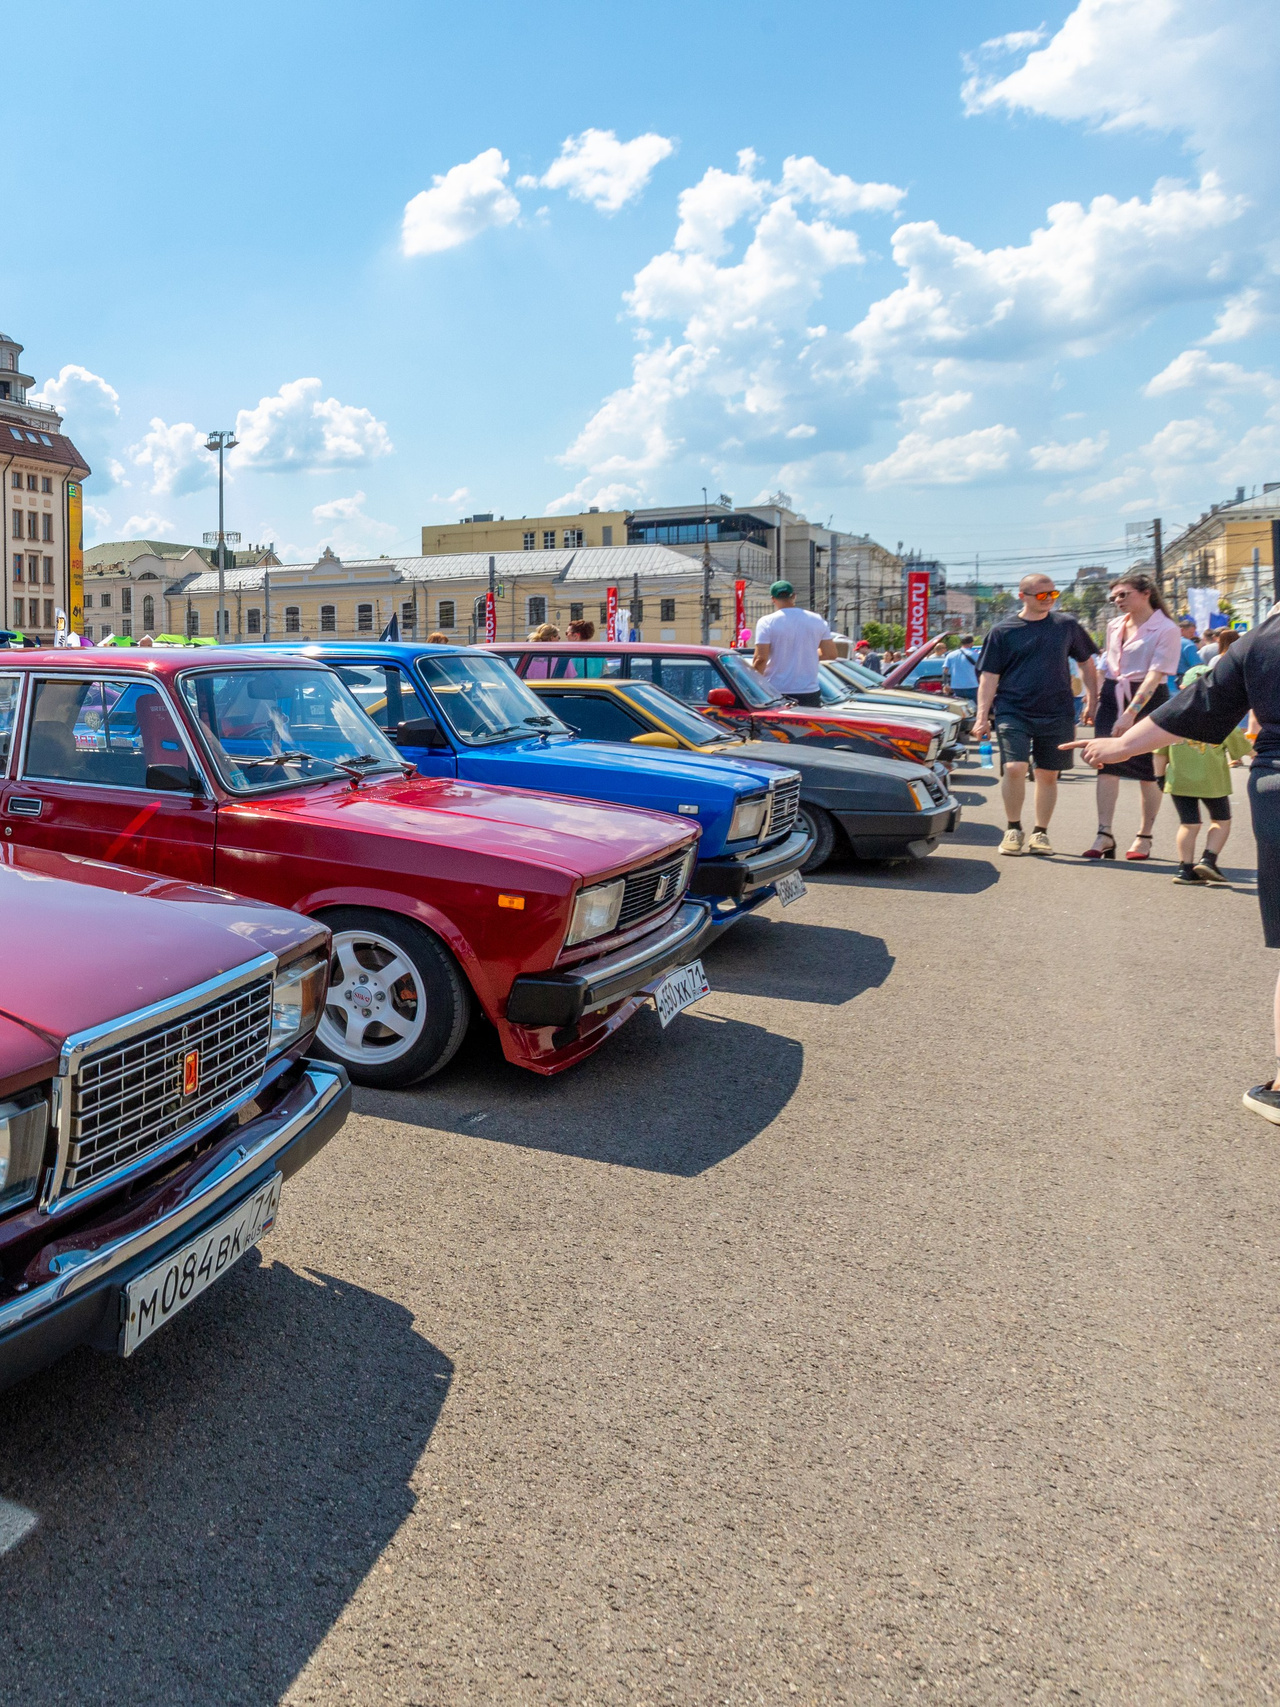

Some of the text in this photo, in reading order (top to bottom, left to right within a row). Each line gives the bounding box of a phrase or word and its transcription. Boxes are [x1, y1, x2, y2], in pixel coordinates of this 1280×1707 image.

[910, 582, 926, 648] auto.ru
[687, 965, 704, 989] 71
[245, 1224, 262, 1247] RUS
[137, 1185, 276, 1338] M084BK 71
